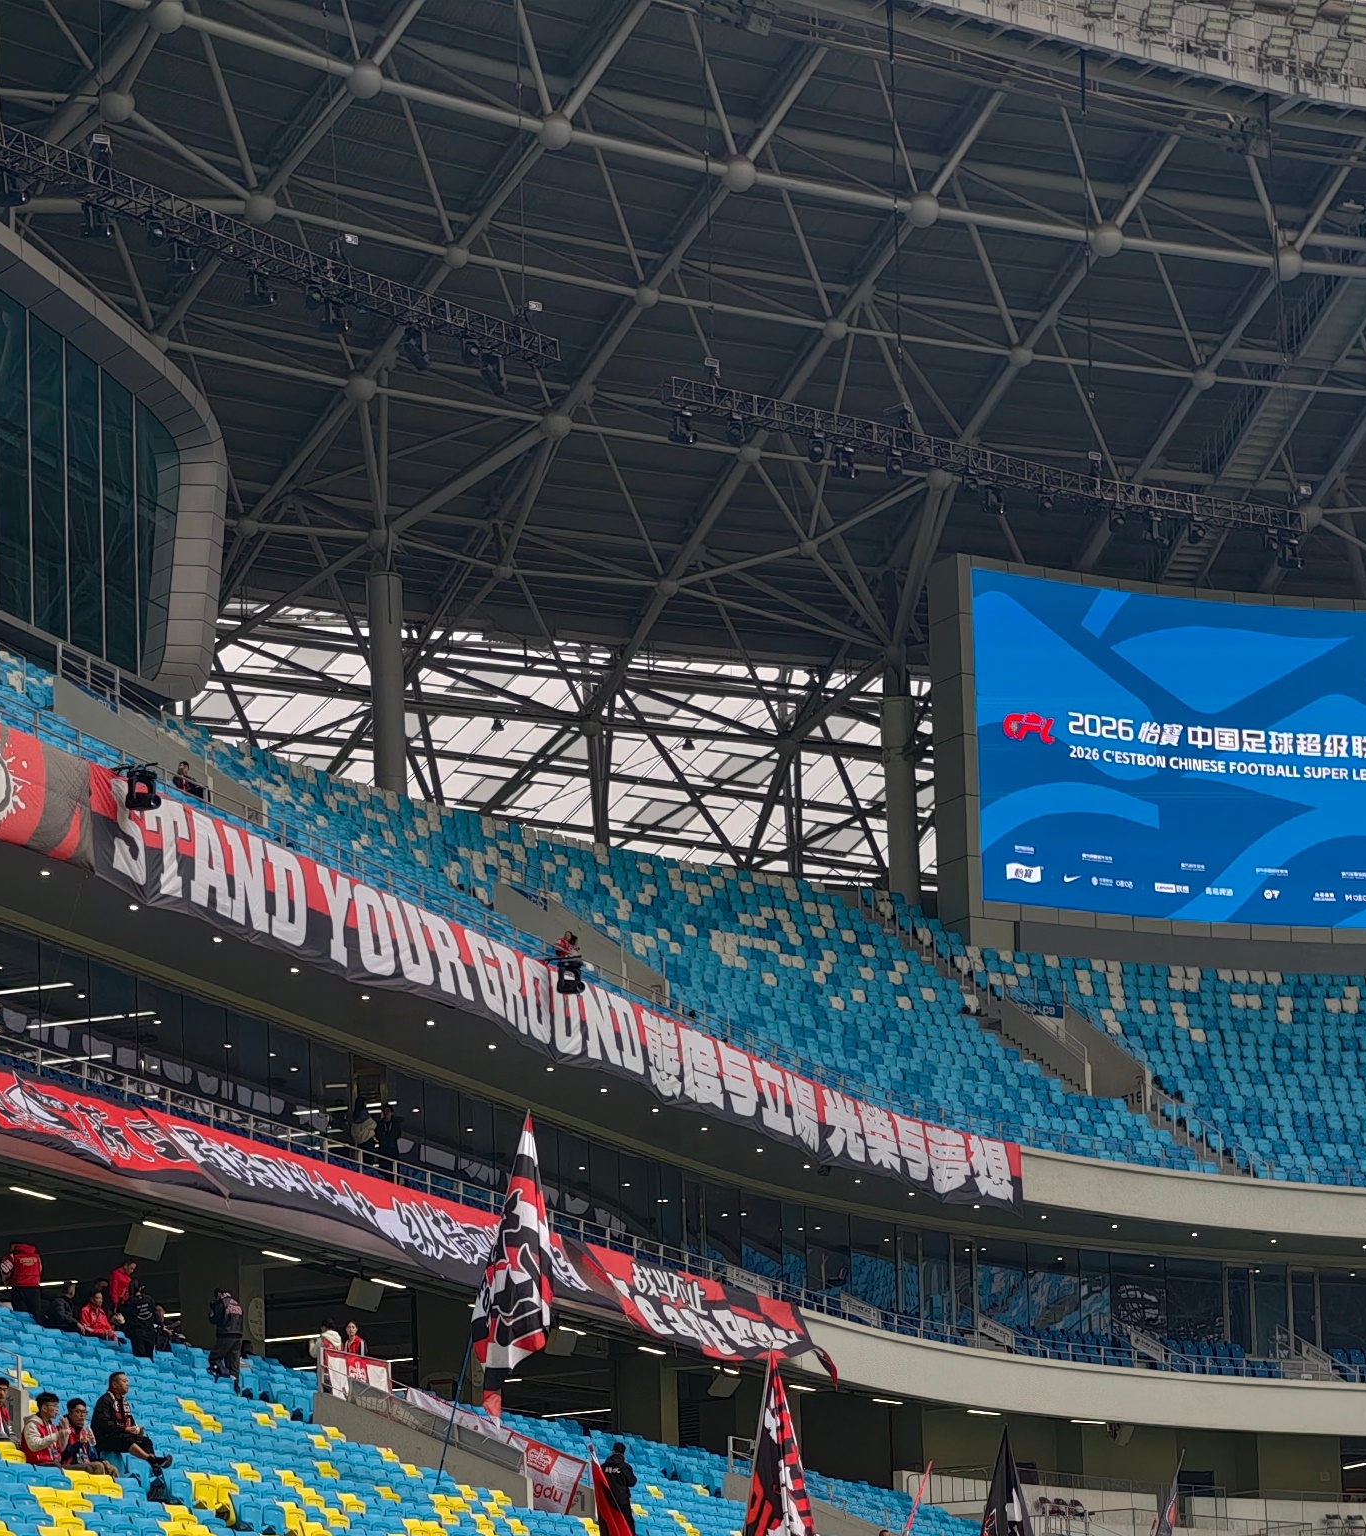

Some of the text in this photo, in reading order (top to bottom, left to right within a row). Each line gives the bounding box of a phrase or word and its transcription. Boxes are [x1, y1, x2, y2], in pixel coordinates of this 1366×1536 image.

[1067, 711, 1135, 742] 2026
[1068, 744, 1100, 762] 2026
[1103, 749, 1167, 769] C'ESTBON
[1168, 755, 1227, 774] CHINESE
[1229, 760, 1302, 779] FOOTBALL
[1303, 766, 1349, 781] SUPER
[110, 777, 308, 947] STAND
[315, 864, 476, 1002] YOUR
[464, 927, 646, 1076] GROUND
[535, 1484, 564, 1504] gdu
